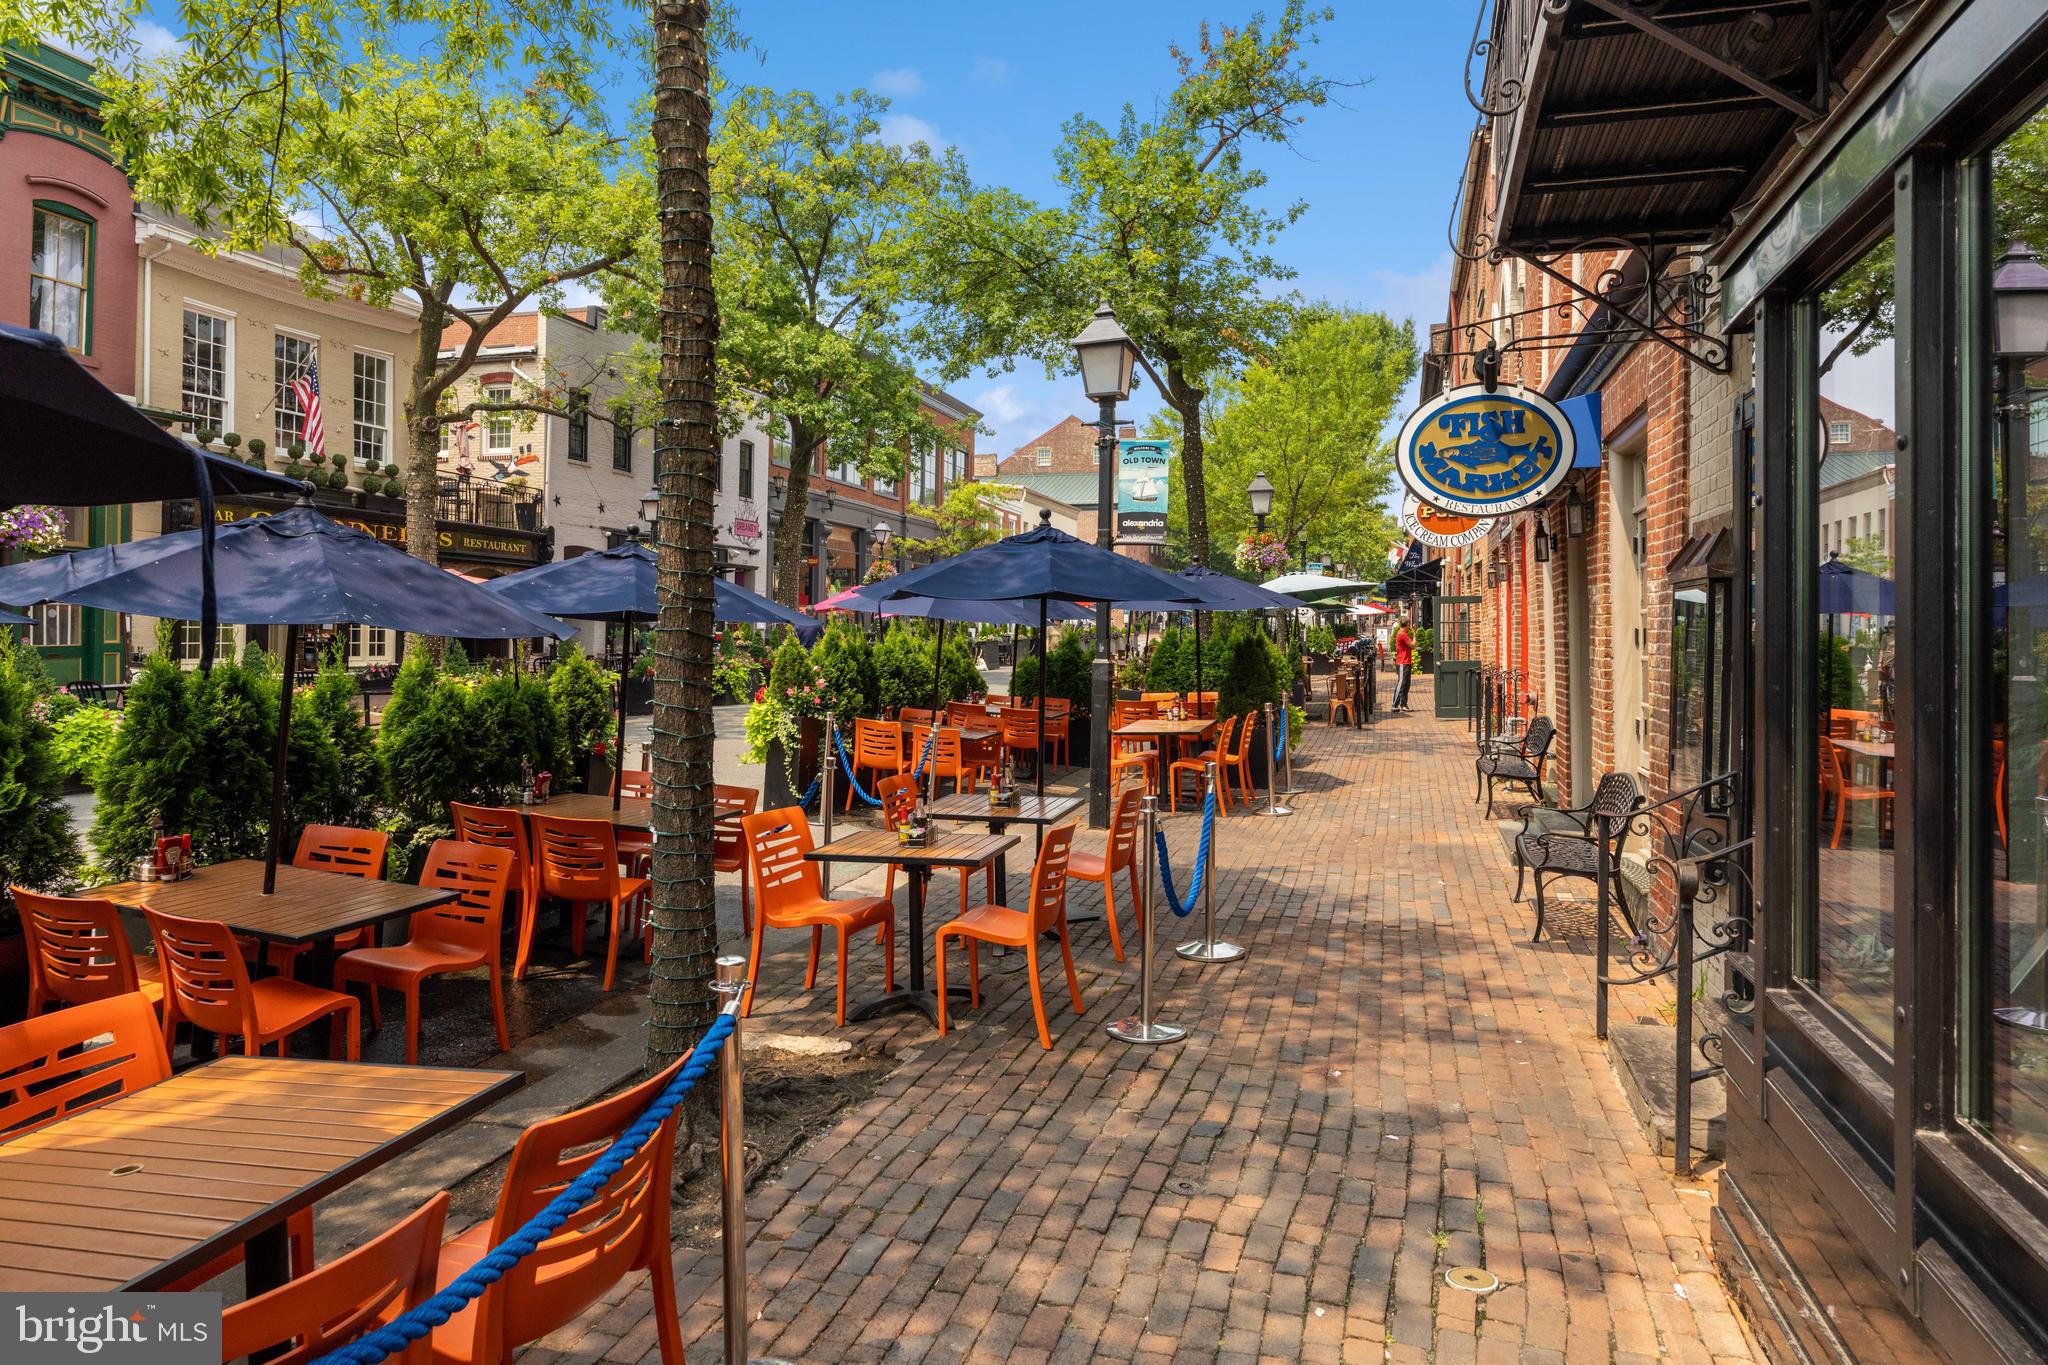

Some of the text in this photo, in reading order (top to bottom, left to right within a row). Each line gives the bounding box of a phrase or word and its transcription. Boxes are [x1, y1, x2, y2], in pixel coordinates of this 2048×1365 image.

[1438, 409, 1526, 442] FISH
[1122, 456, 1166, 465] OLD TOWN
[1419, 435, 1553, 493] MARKET
[1444, 495, 1530, 515] RESTAURANT
[214, 509, 234, 522] AR
[1122, 518, 1164, 527] alexandria
[1404, 512, 1417, 531] ICE
[1414, 525, 1448, 547] CREAM
[1451, 516, 1494, 546] COMPAN
[463, 537, 527, 553] RESTAURANT
